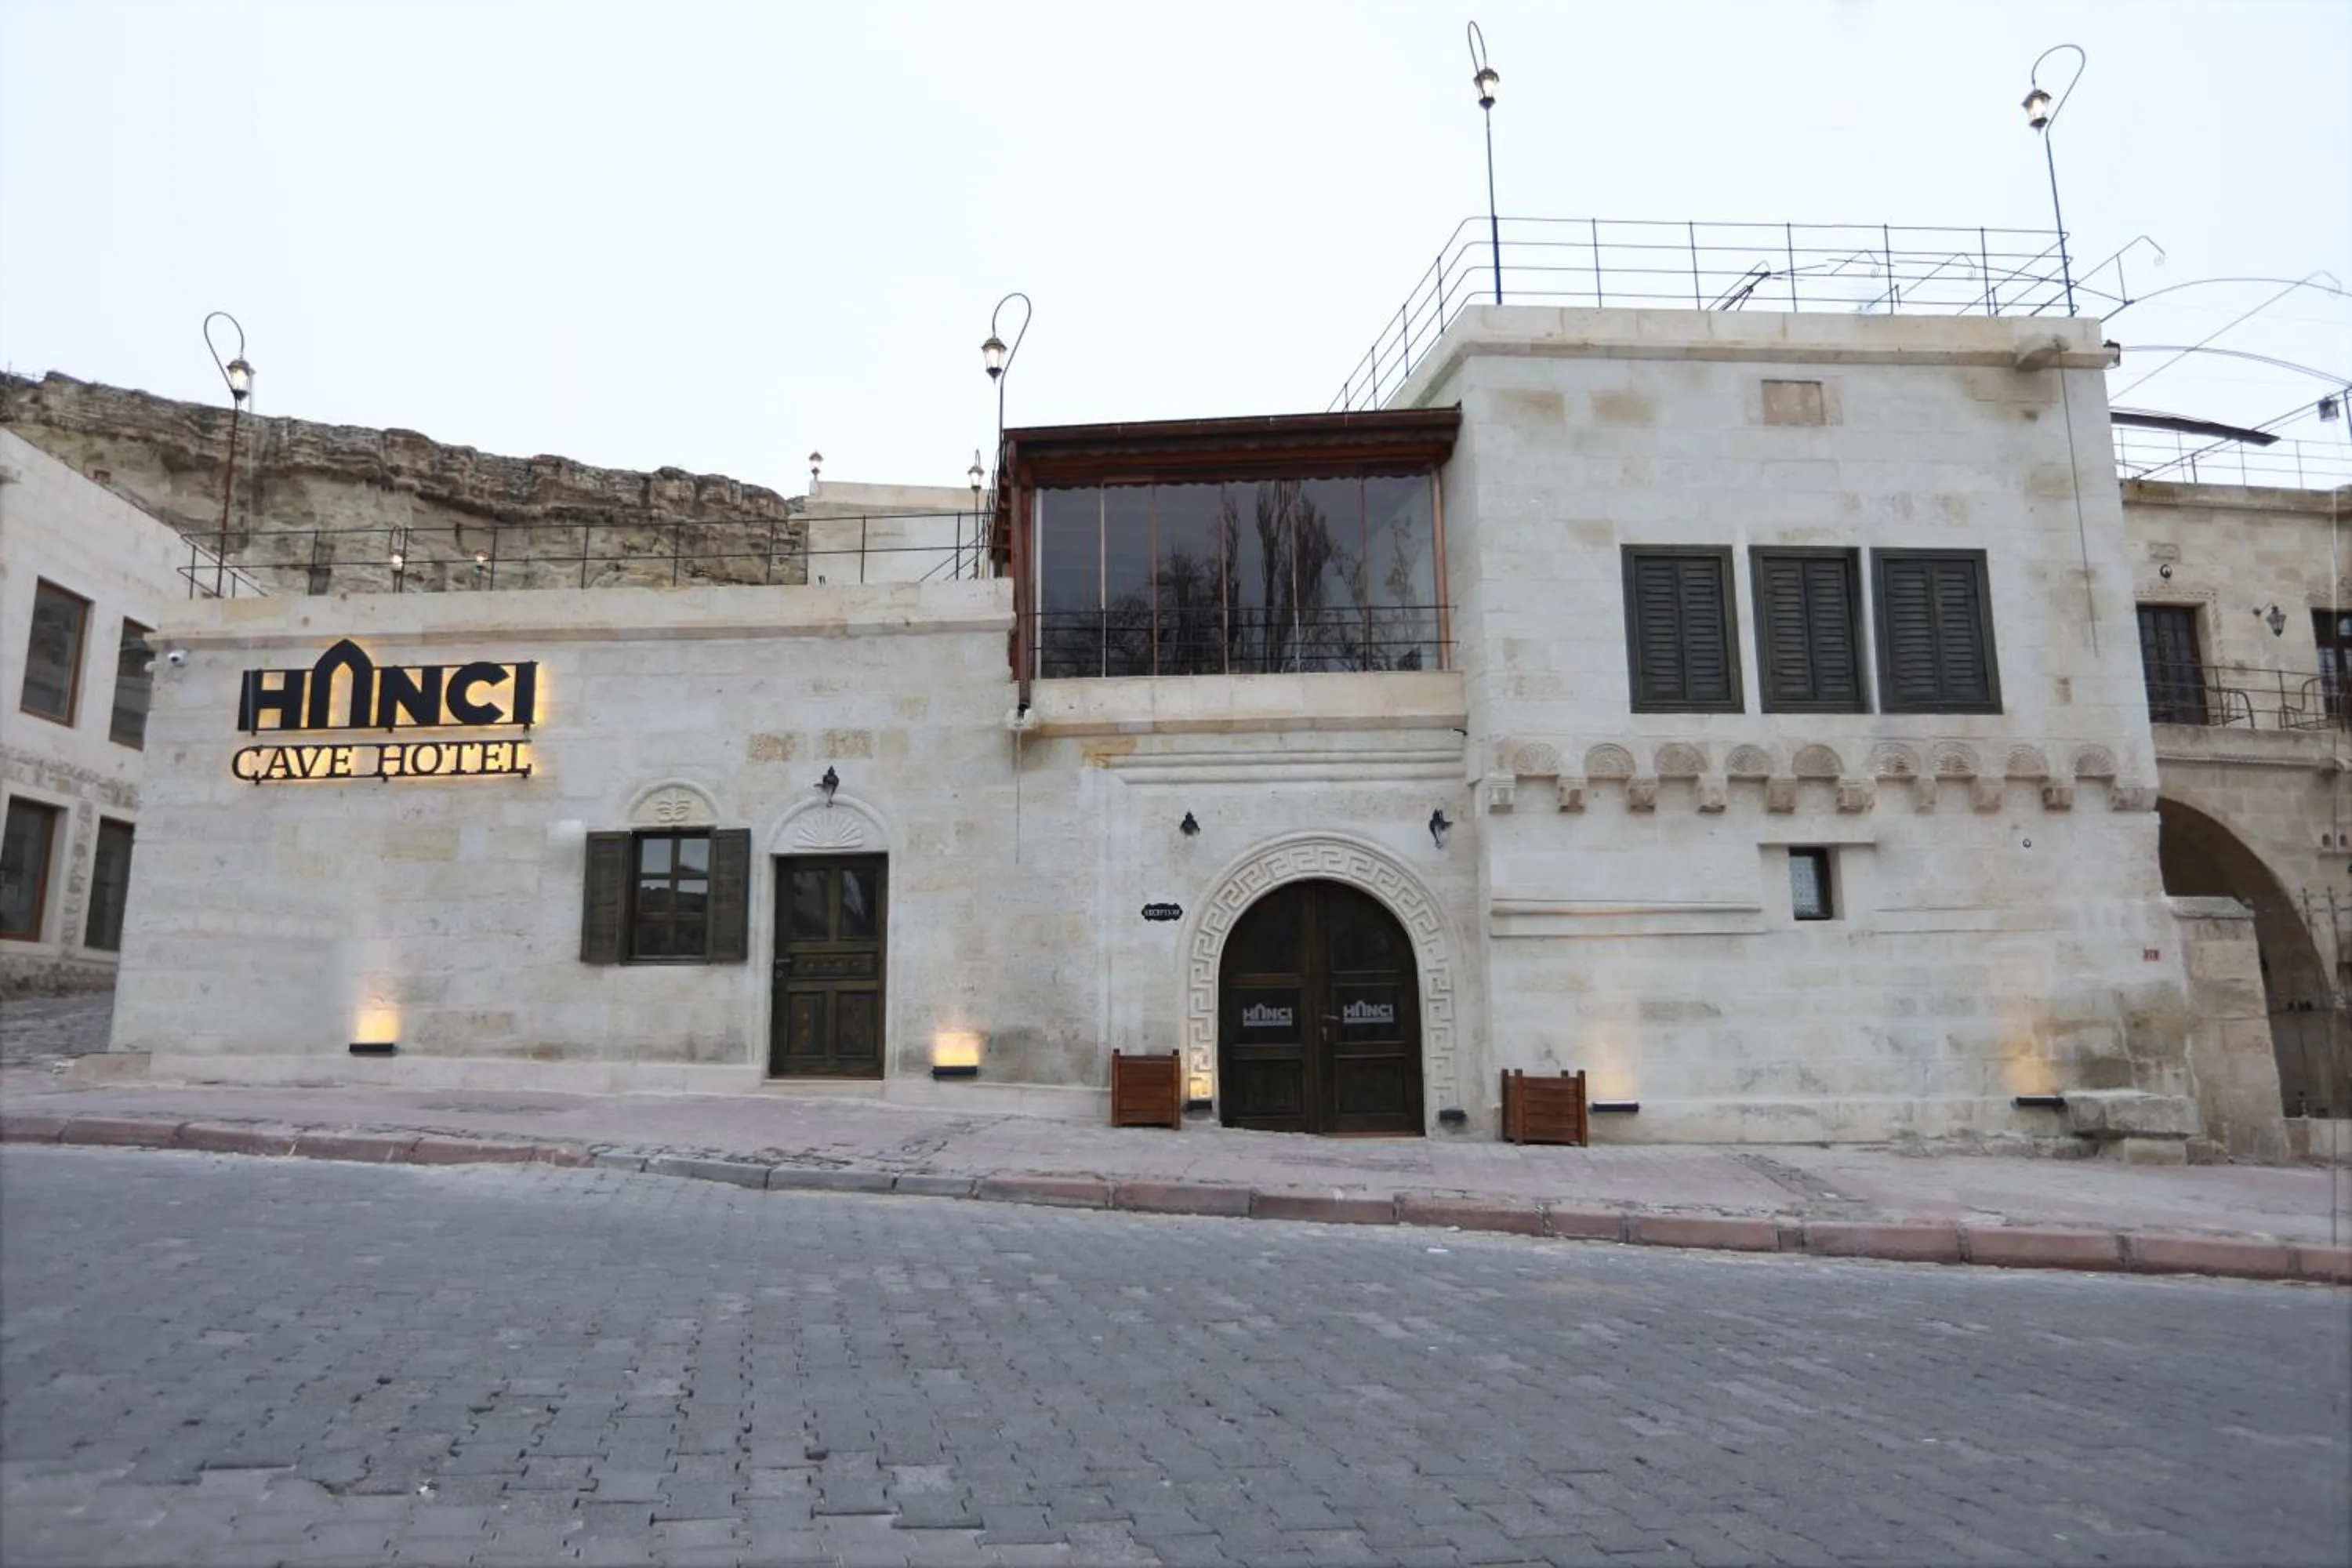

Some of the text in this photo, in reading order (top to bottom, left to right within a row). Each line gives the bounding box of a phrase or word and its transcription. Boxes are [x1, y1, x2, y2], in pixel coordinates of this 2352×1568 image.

[238, 638, 537, 731] HANCI
[232, 741, 532, 781] CAVE HOTEL
